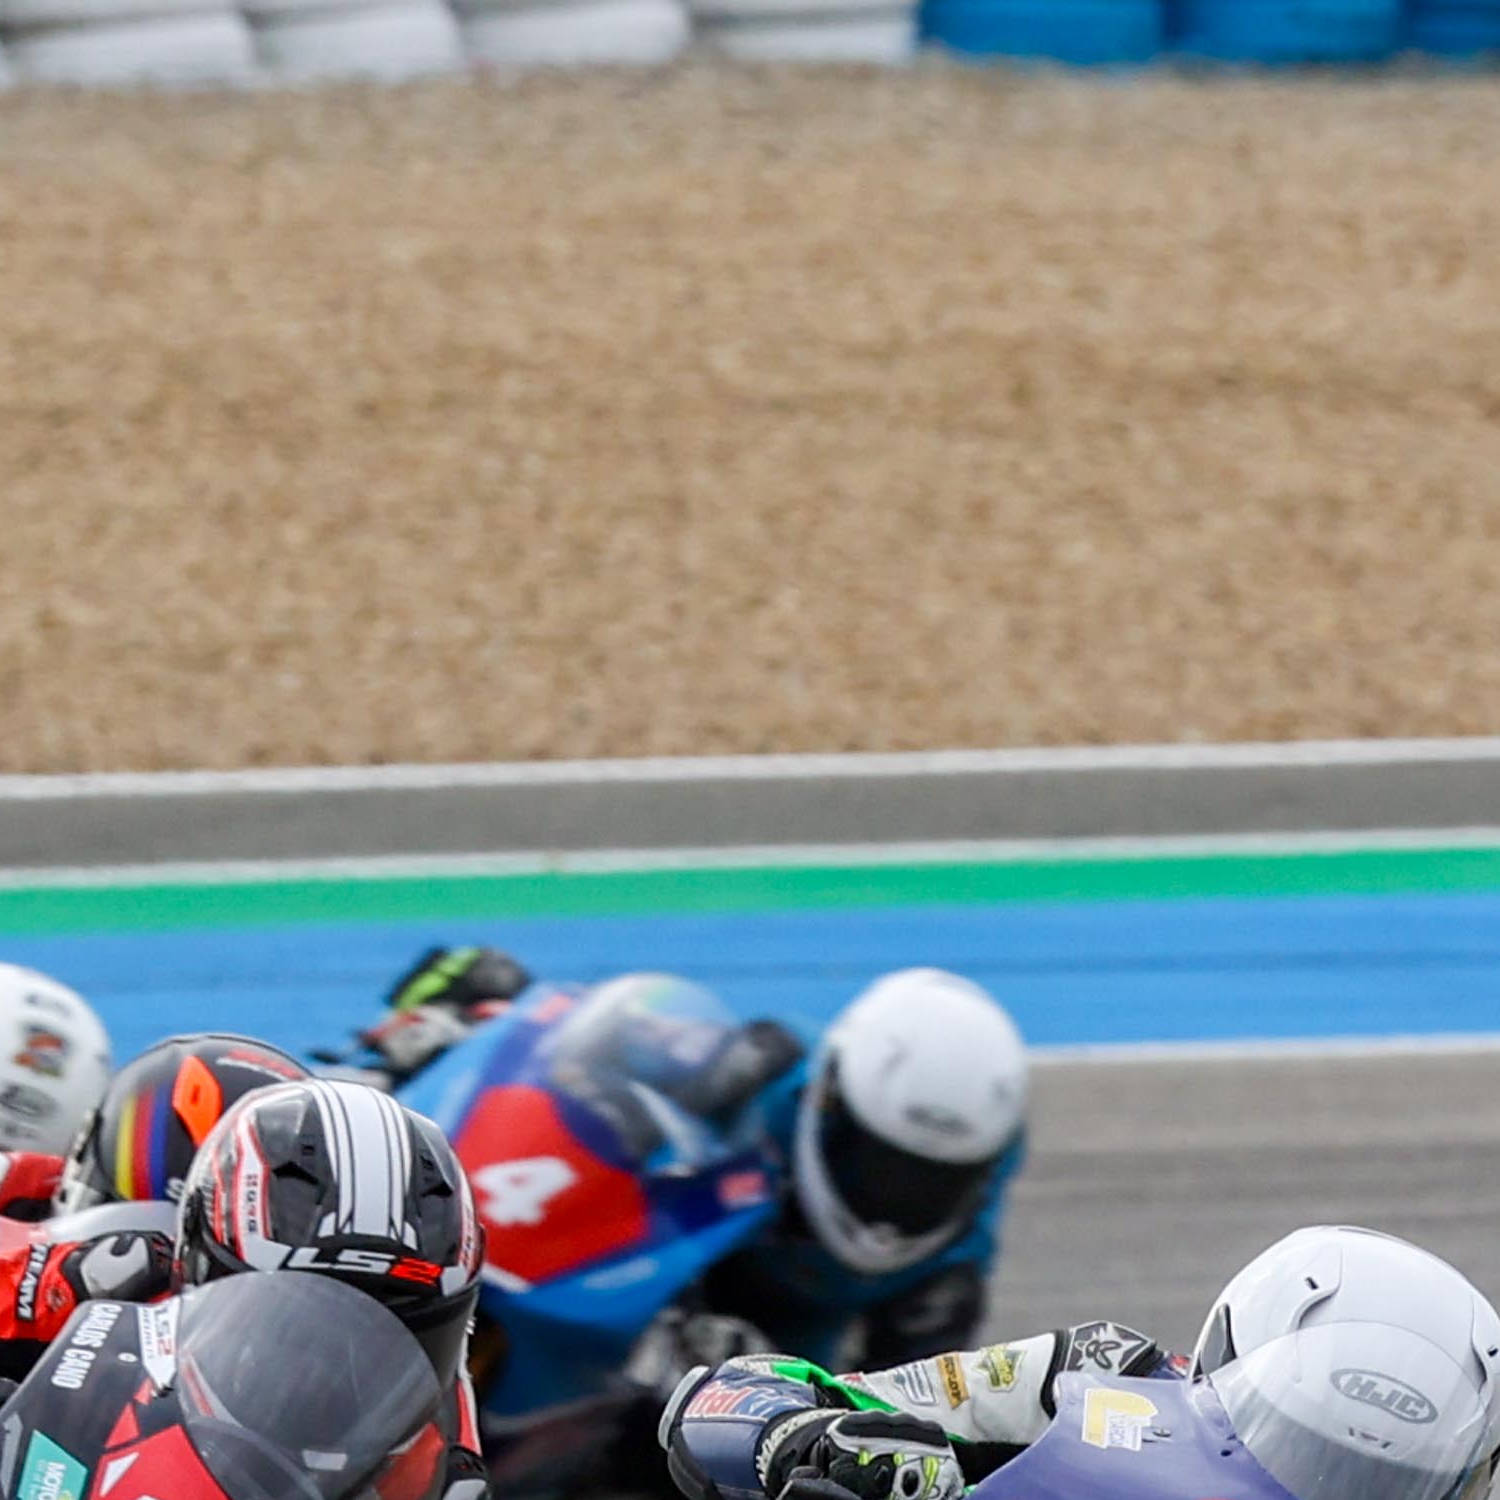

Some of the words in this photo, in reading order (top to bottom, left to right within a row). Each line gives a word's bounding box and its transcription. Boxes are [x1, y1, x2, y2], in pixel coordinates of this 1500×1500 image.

[473, 1156, 578, 1226] 4
[286, 1248, 442, 1285] LS2
[72, 1303, 122, 1348] CARLOS
[52, 1348, 96, 1389] CANO
[1342, 1374, 1426, 1418] HJC
